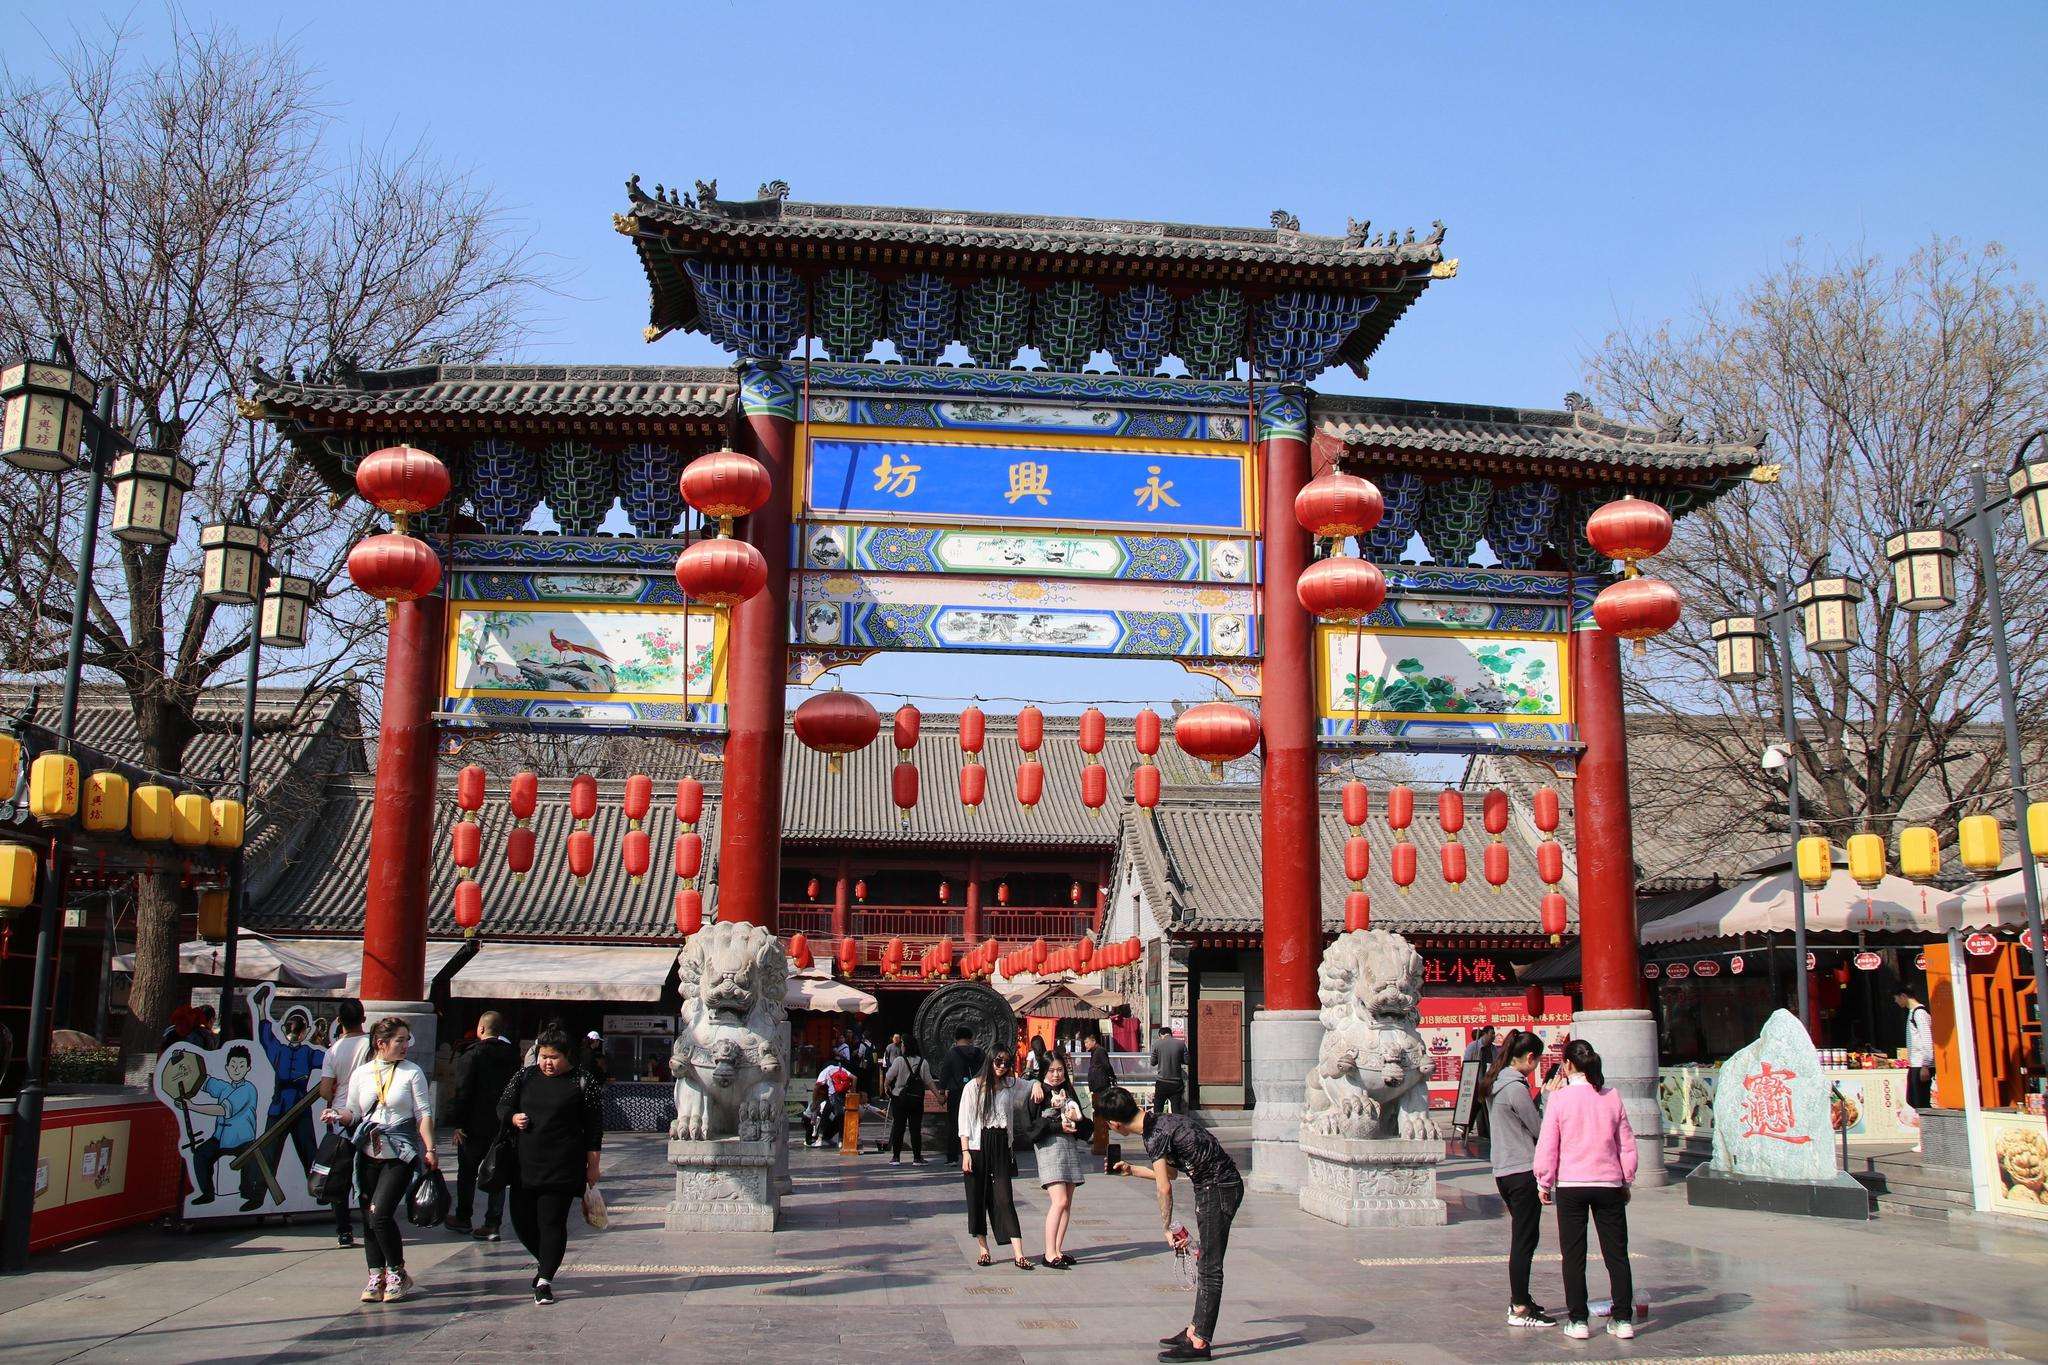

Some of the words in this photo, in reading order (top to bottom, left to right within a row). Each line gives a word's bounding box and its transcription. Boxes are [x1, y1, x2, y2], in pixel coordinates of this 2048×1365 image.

[35, 401, 54, 446] 永興坊
[873, 452, 1182, 513] 永興坊
